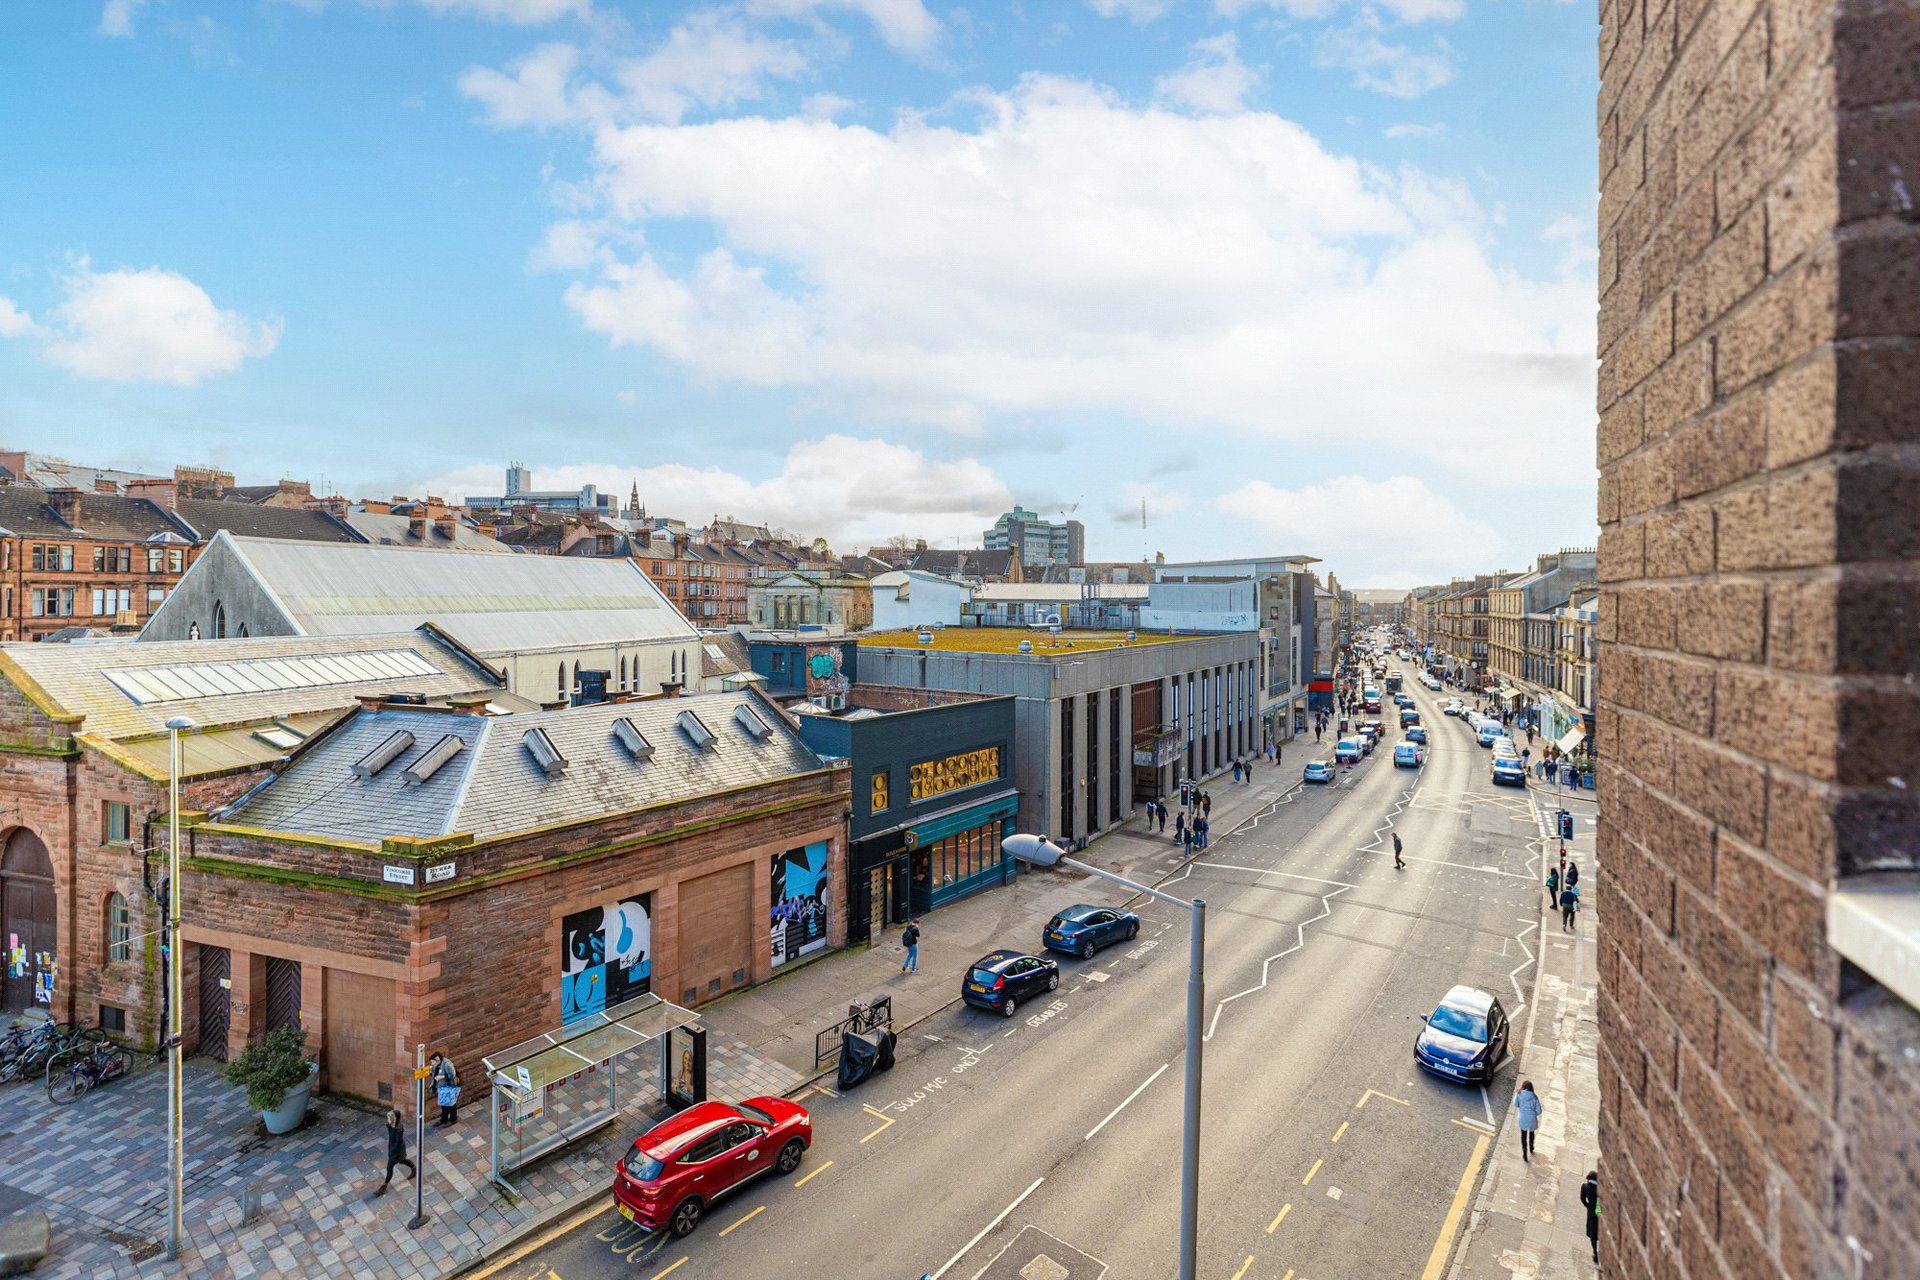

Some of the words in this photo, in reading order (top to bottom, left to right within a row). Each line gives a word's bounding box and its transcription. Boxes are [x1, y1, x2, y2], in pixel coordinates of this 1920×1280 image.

[1026, 1001, 1069, 1028] DISABLED
[894, 1091, 926, 1112] SOLO
[951, 1054, 981, 1073] ONLY
